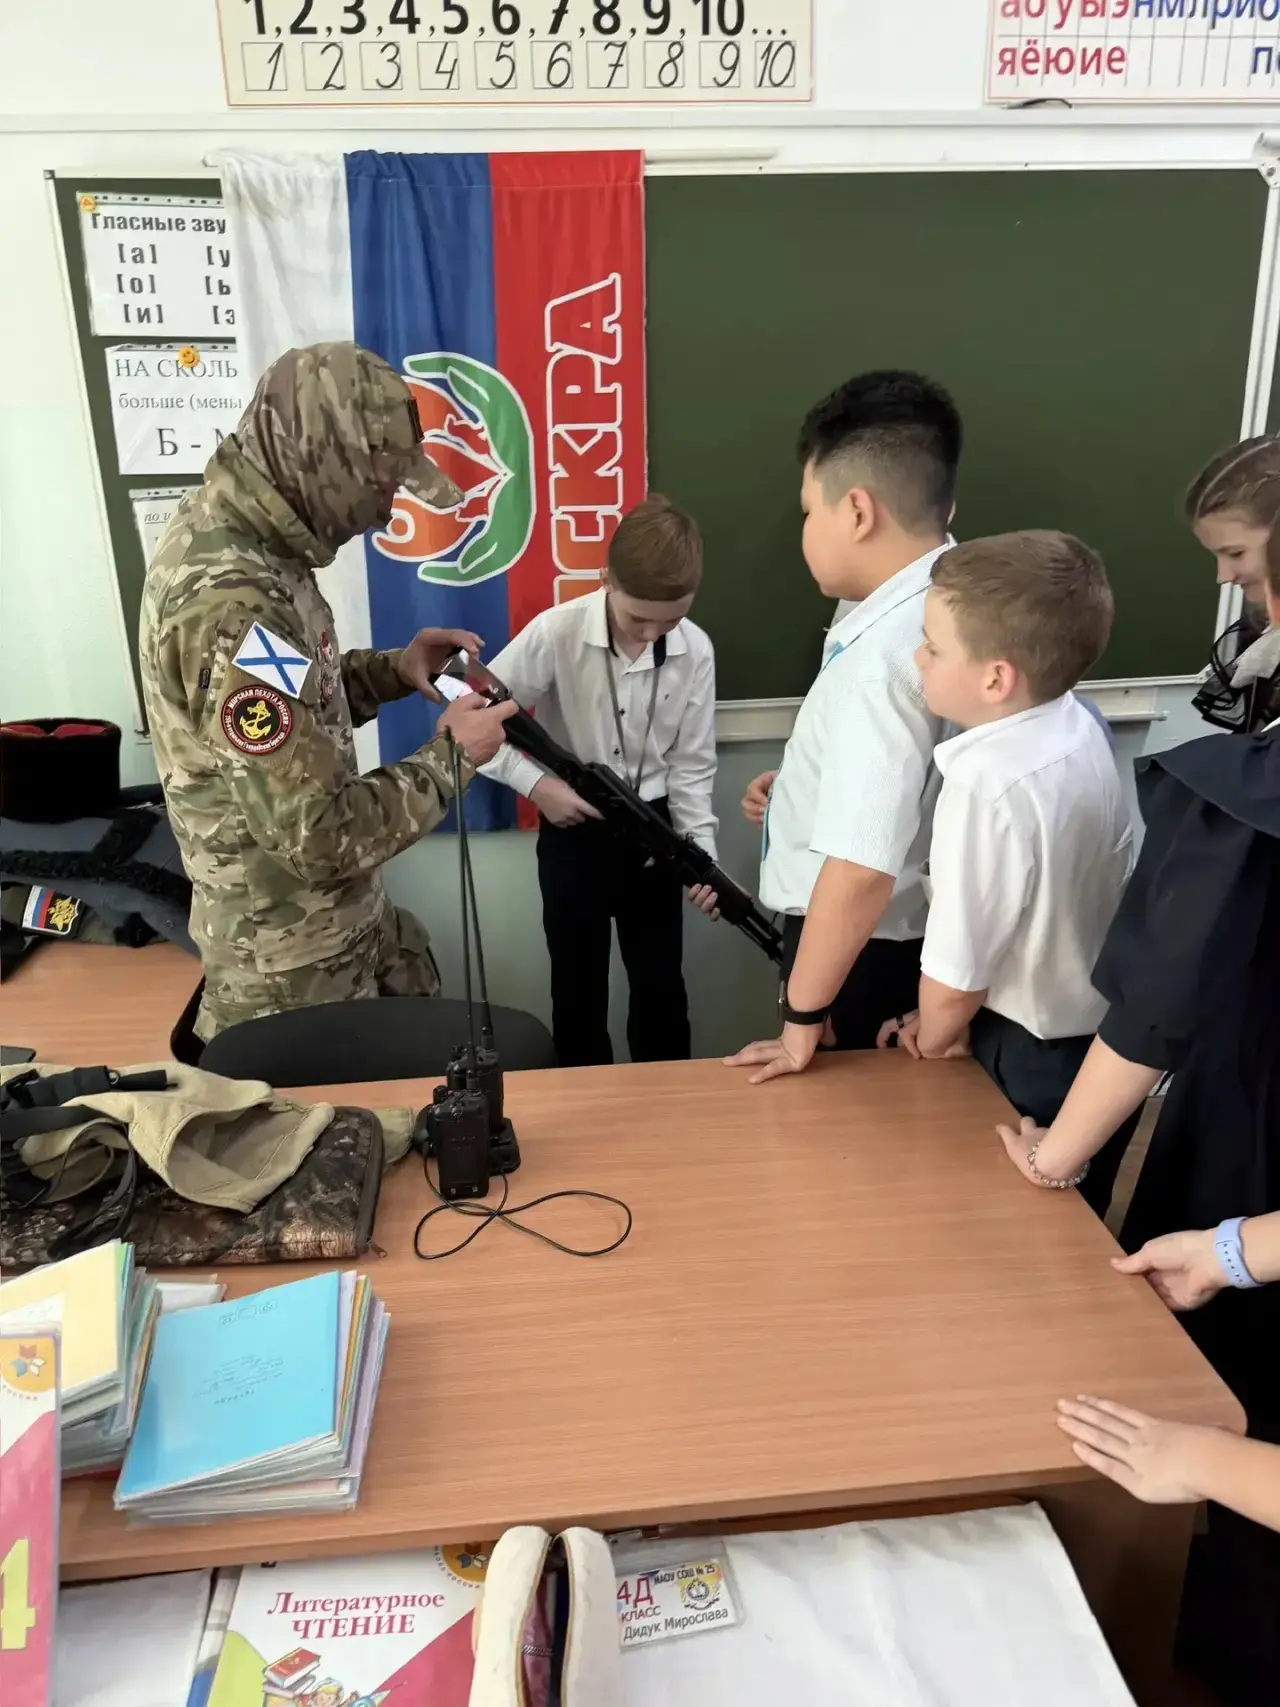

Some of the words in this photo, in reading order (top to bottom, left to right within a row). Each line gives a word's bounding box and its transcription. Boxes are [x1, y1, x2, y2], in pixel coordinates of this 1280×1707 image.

[92, 212, 186, 232] Гласные
[115, 359, 150, 377] НА
[157, 359, 238, 378] СКОЛЬ
[118, 392, 184, 409] больше
[155, 428, 179, 456] Б
[676, 1568, 695, 1581] СОШ
[267, 1592, 445, 1616] Литературное
[617, 1577, 653, 1608] 4Д
[292, 1614, 415, 1640] ЧТЕНИЕ
[624, 1624, 661, 1641] Дидук
[665, 1608, 728, 1630] Мирослава
